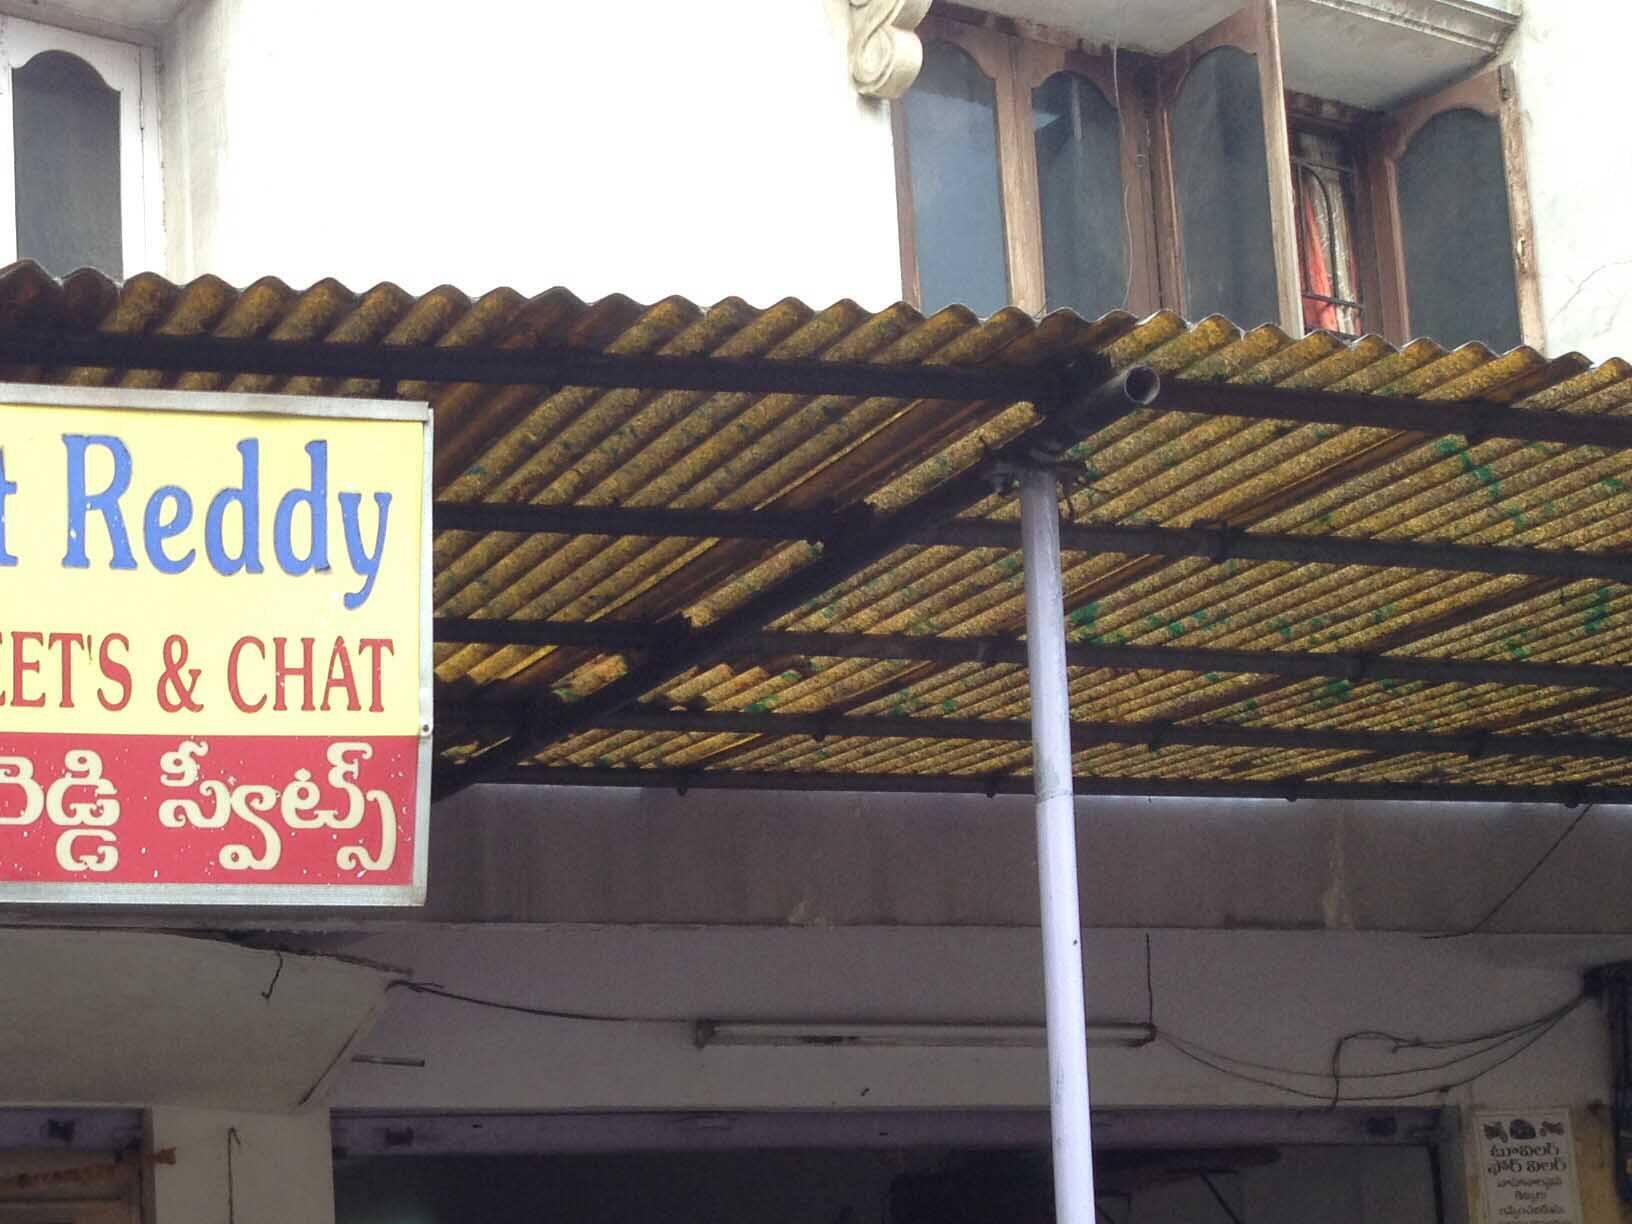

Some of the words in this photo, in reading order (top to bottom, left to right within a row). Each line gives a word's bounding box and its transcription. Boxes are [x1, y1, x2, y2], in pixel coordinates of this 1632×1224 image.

[61, 432, 393, 611] Reddy
[156, 633, 204, 714] &
[226, 635, 395, 714] CHAT
[157, 739, 398, 872] స్వీట్స్
